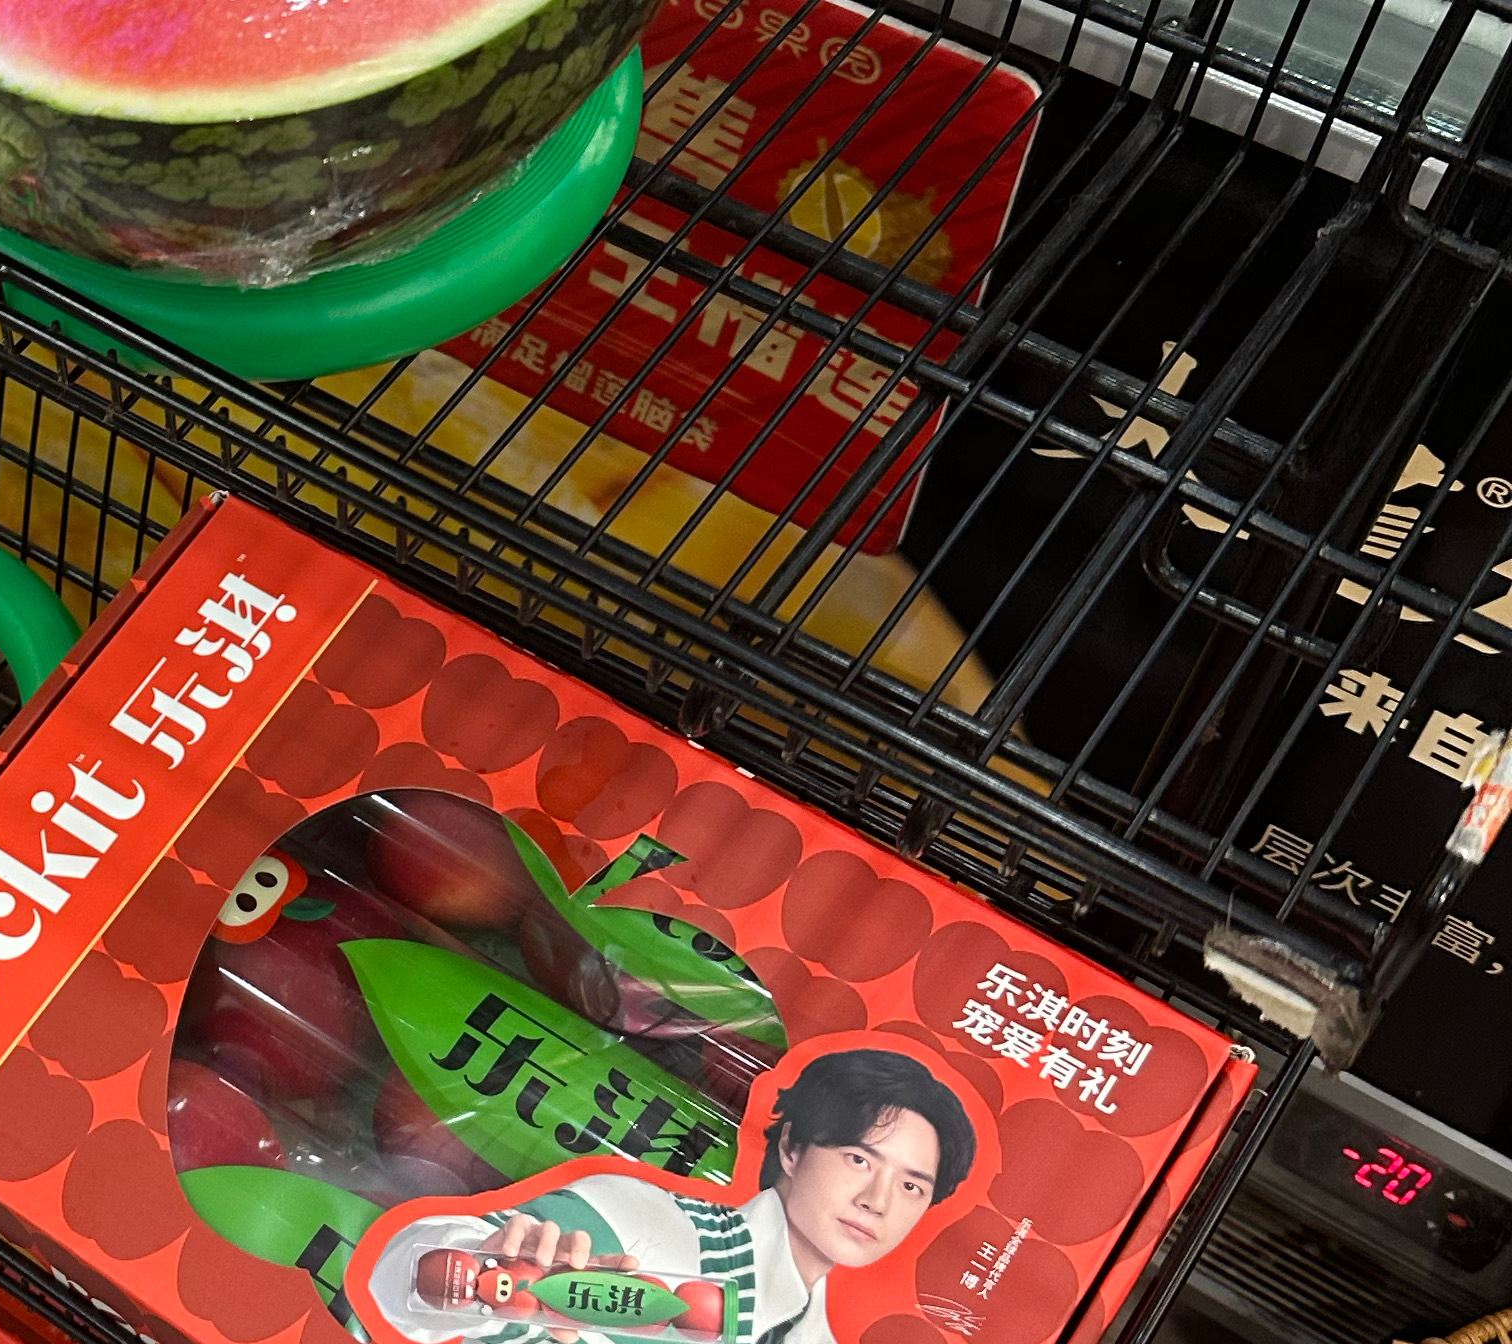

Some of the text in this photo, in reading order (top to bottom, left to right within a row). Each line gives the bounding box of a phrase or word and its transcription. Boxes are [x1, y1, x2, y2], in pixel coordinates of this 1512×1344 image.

[109, 572, 298, 770] 乐淇
[952, 997, 1121, 1115] 宠爱有礼
[977, 961, 1153, 1076] 乐淇时刻
[1342, 1147, 1433, 1206] -20
[568, 1281, 646, 1316] 乐淇
[959, 1240, 998, 1292] 王一博
